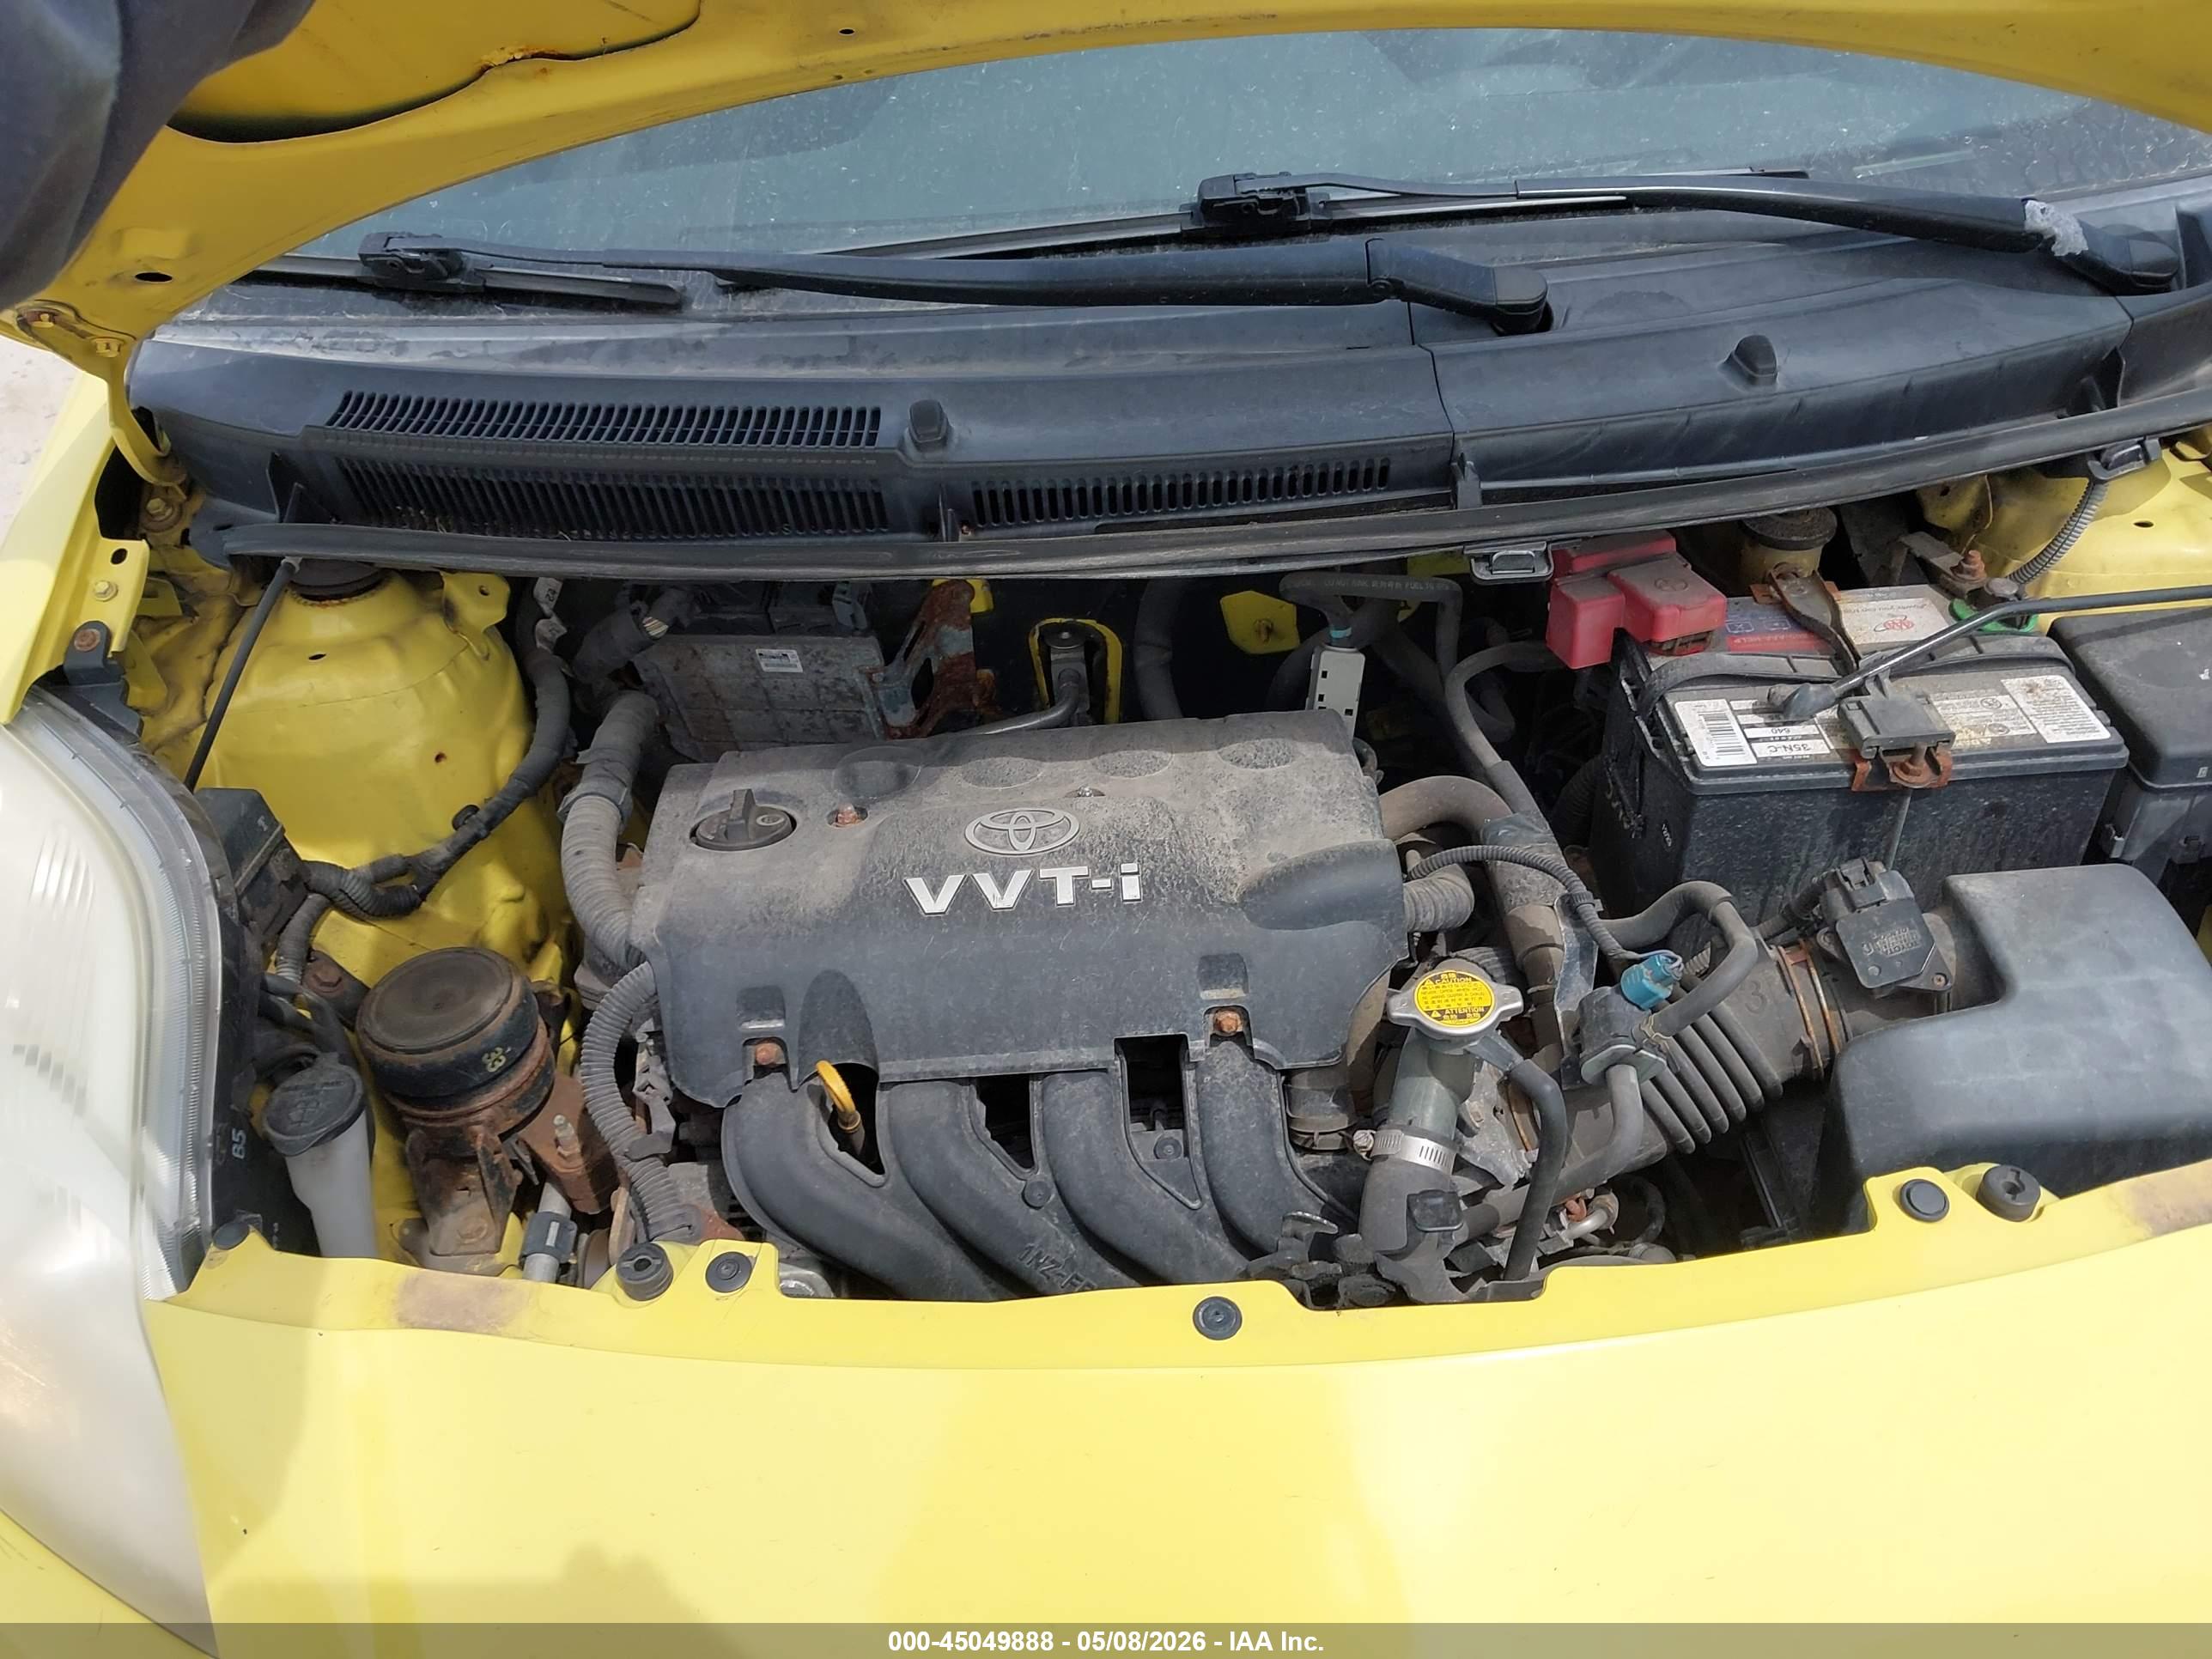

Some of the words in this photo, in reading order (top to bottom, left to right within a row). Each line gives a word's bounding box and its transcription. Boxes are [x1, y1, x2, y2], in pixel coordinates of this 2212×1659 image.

[1767, 743, 1812, 753] 35N-C
[904, 863, 1141, 915] VVT-i
[1444, 1006, 1485, 1015] ATTENTION
